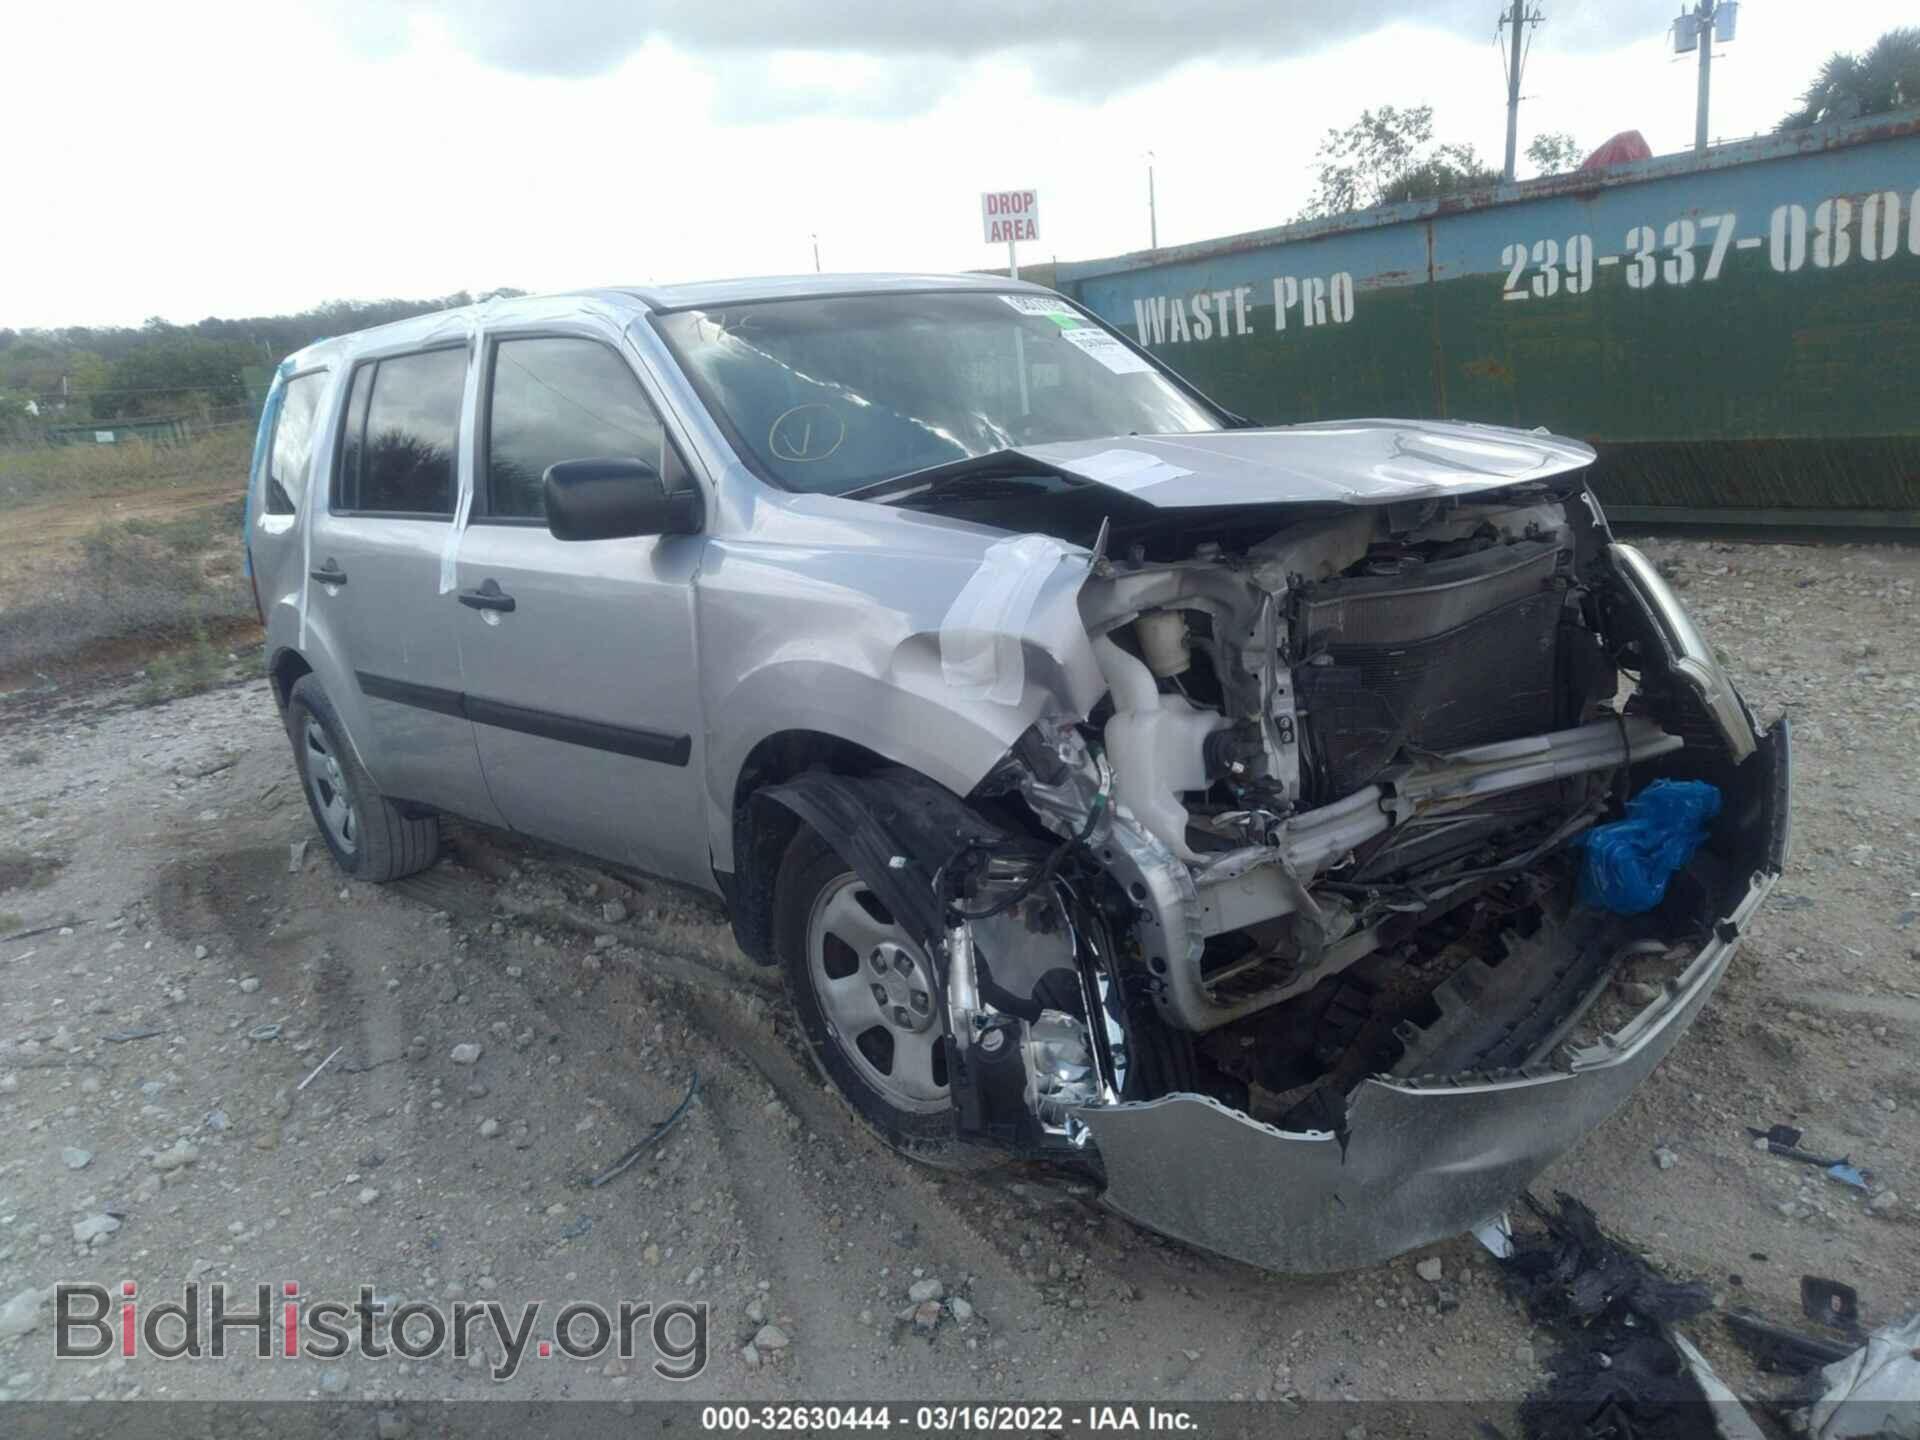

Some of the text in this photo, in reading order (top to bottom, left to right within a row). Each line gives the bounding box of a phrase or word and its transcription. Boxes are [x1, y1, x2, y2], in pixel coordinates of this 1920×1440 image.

[987, 192, 1034, 215] DROP
[991, 218, 1036, 241] AREA
[1134, 272, 1355, 346] WASTE PRO
